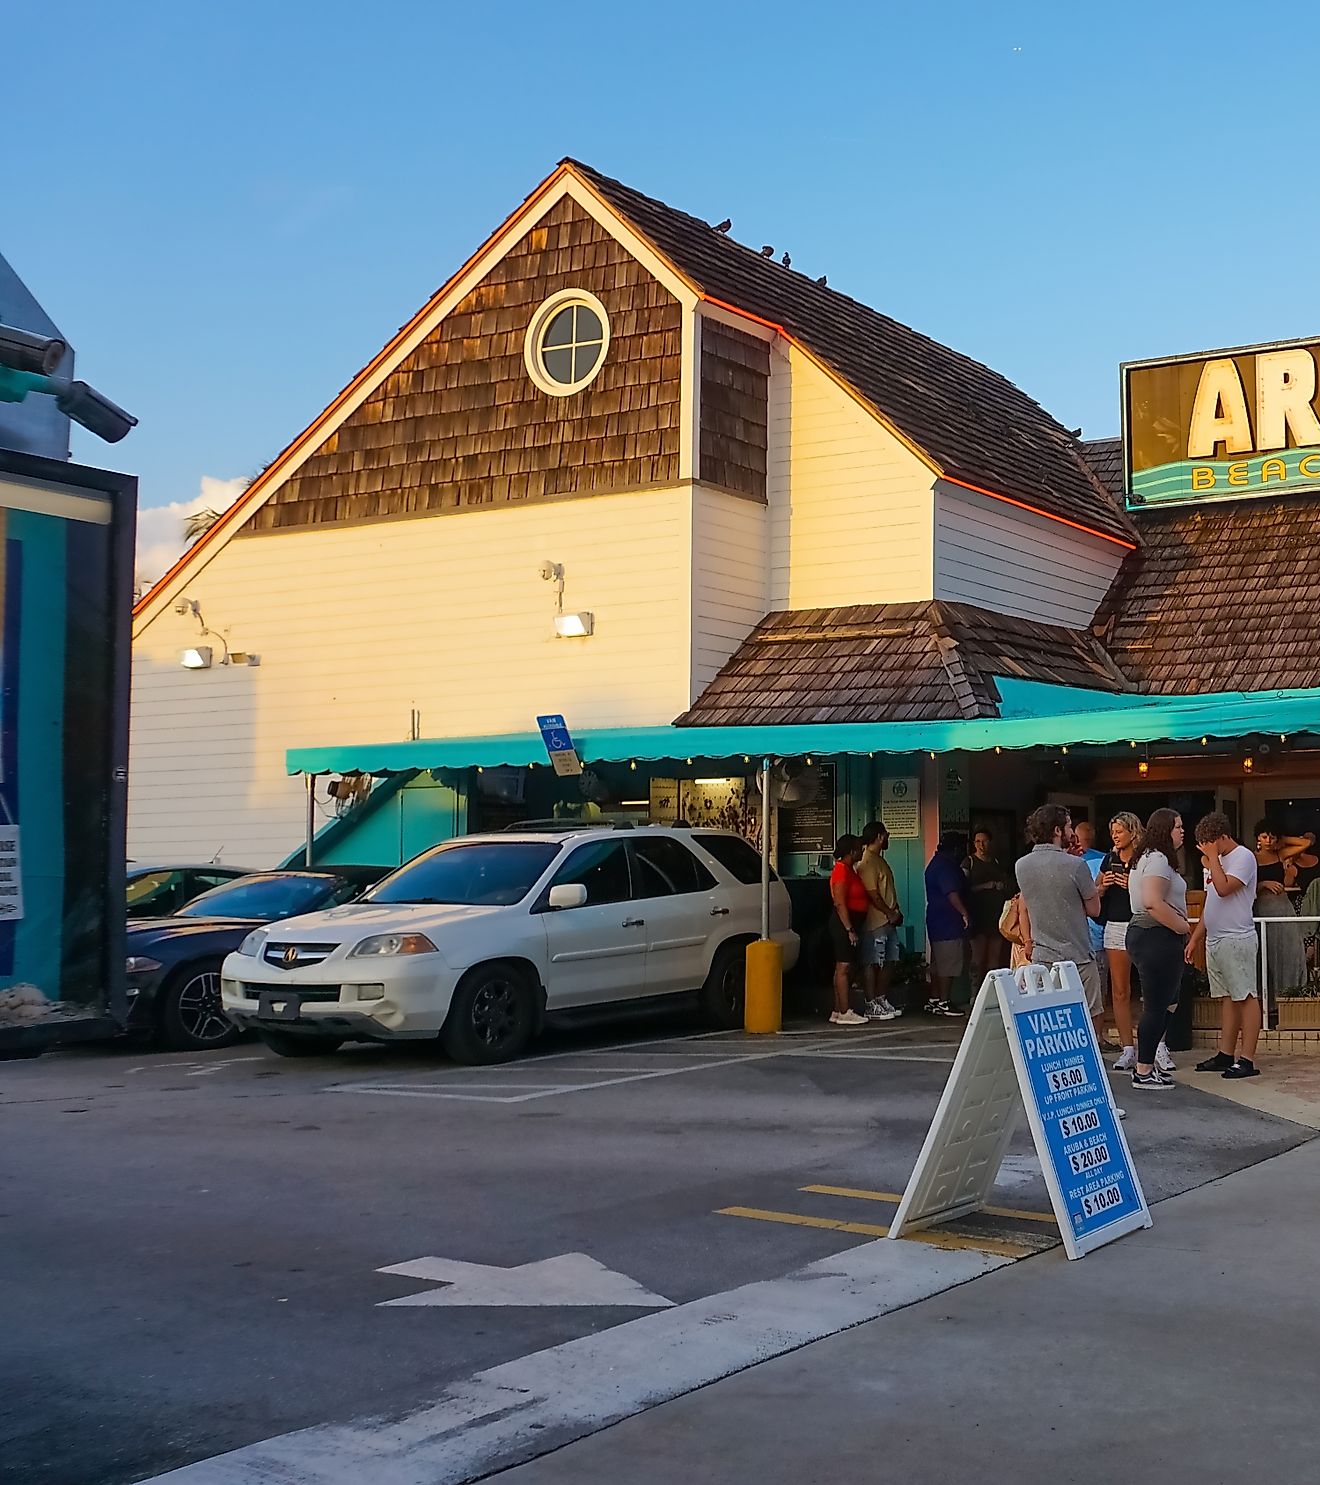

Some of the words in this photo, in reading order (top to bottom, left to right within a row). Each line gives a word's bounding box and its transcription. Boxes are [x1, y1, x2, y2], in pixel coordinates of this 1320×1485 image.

[1027, 1008, 1073, 1035] VALET
[1025, 1028, 1088, 1060] PARKING
[1041, 1061, 1061, 1073] LUNCH
[1065, 1055, 1085, 1067] DINNER
[1061, 1069, 1083, 1087] 6.00
[1044, 1095, 1053, 1105] UP
[1054, 1089, 1073, 1102] FRONT
[1073, 1083, 1097, 1097] PARKING
[1056, 1105, 1073, 1117] LUNCH
[1076, 1099, 1094, 1110] DINNER
[1094, 1096, 1106, 1106] ONLY
[1062, 1120, 1071, 1136] $
[1072, 1112, 1098, 1133] 10.00
[1063, 1141, 1083, 1155] ARUBA
[1084, 1138, 1089, 1148] &
[1089, 1132, 1108, 1146] BEACH
[1072, 1155, 1080, 1172] $
[1081, 1145, 1107, 1168] 20.00
[1085, 1171, 1093, 1179] ALL
[1094, 1166, 1104, 1176] DAY
[1069, 1185, 1085, 1200] REST
[1085, 1179, 1101, 1193] AREA
[1100, 1170, 1125, 1187] PARKING
[1084, 1198, 1093, 1216] $
[1094, 1187, 1120, 1211] 10.00
